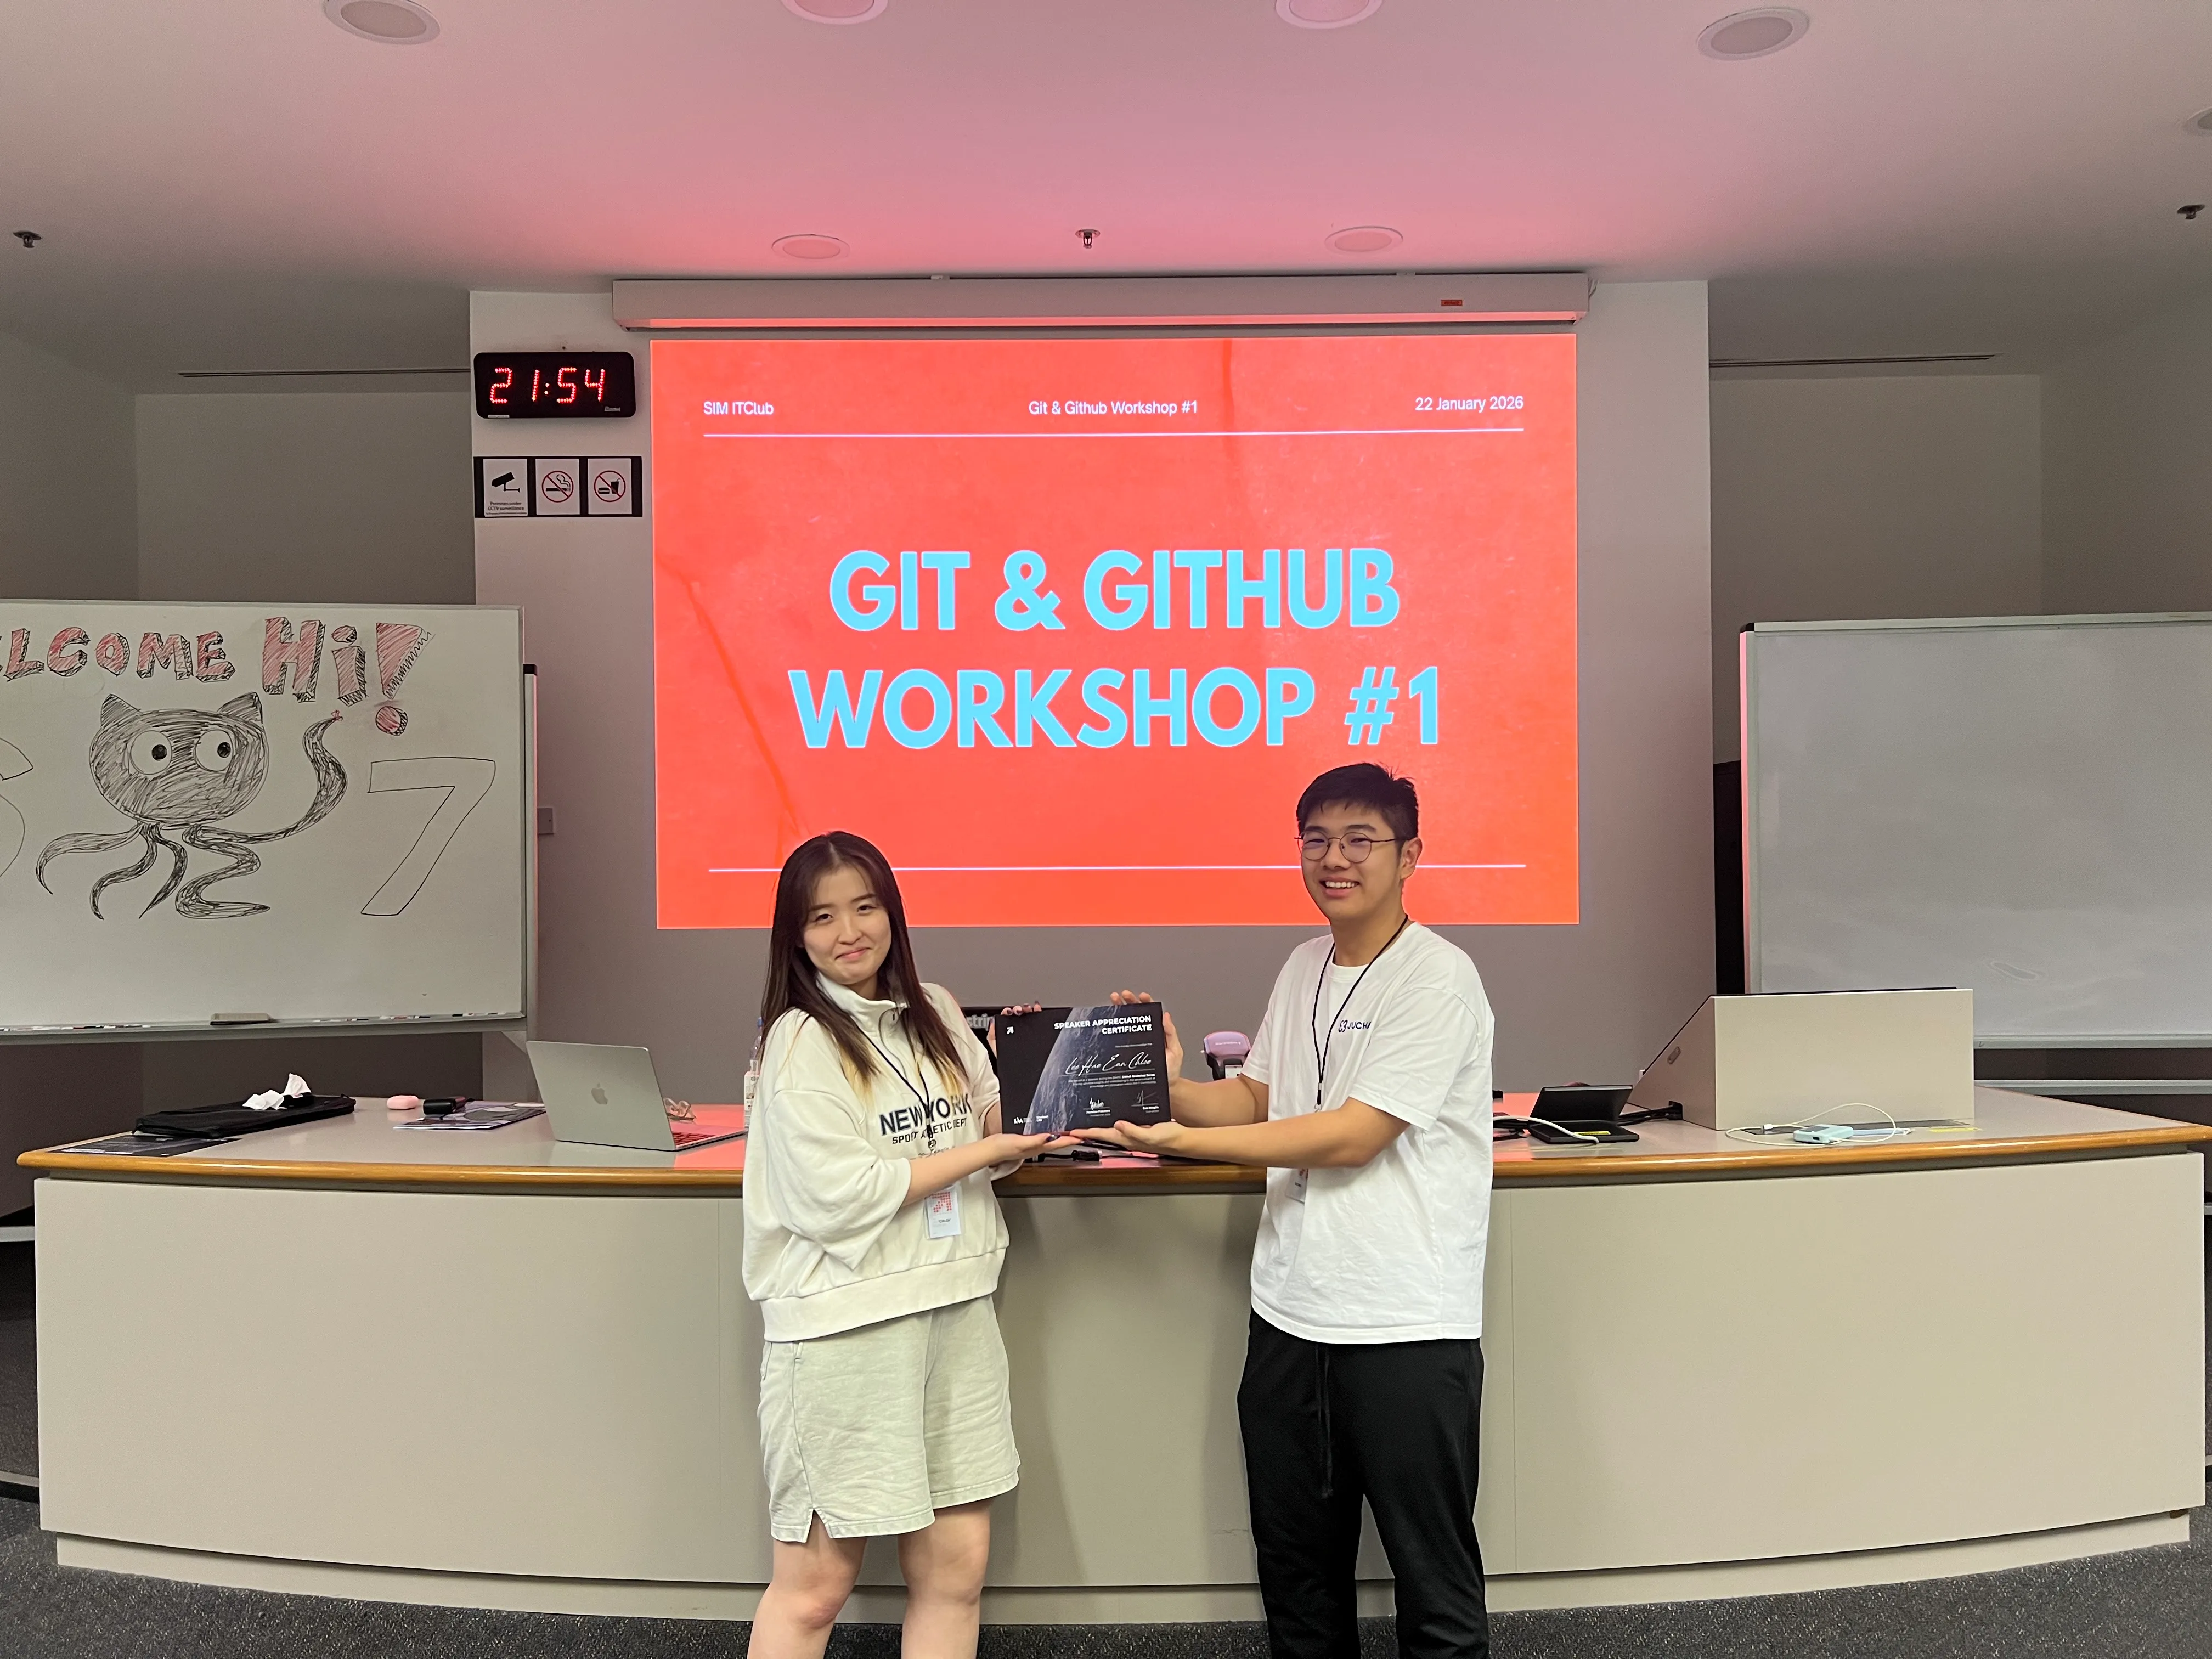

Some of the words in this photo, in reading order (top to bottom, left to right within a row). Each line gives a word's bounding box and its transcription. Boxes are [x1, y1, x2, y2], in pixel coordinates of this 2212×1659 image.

[490, 367, 606, 404] 21:54
[704, 401, 728, 415] SIM
[732, 401, 774, 415] ITClub
[1029, 401, 1048, 415] Git
[1051, 401, 1062, 415] &
[1065, 401, 1107, 415] Github
[1111, 400, 1178, 417] Workshop
[1182, 400, 1197, 414] #1
[1415, 397, 1433, 411] 22
[1436, 397, 1486, 414] January
[1489, 396, 1524, 410] 2026
[830, 550, 971, 631] GIT
[994, 550, 1066, 631] &
[1083, 549, 1401, 631] GITHUB
[0, 627, 236, 682] LCOME
[788, 667, 1316, 749] WORKSHOP
[1344, 666, 1438, 746] #1
[361, 757, 496, 916] 7
[1054, 1020, 1091, 1030] SPEAKER
[1092, 1015, 1152, 1026] APPRECIATION
[1102, 1024, 1152, 1035] CERTIFICATE
[879, 1104, 923, 1135] NEW
